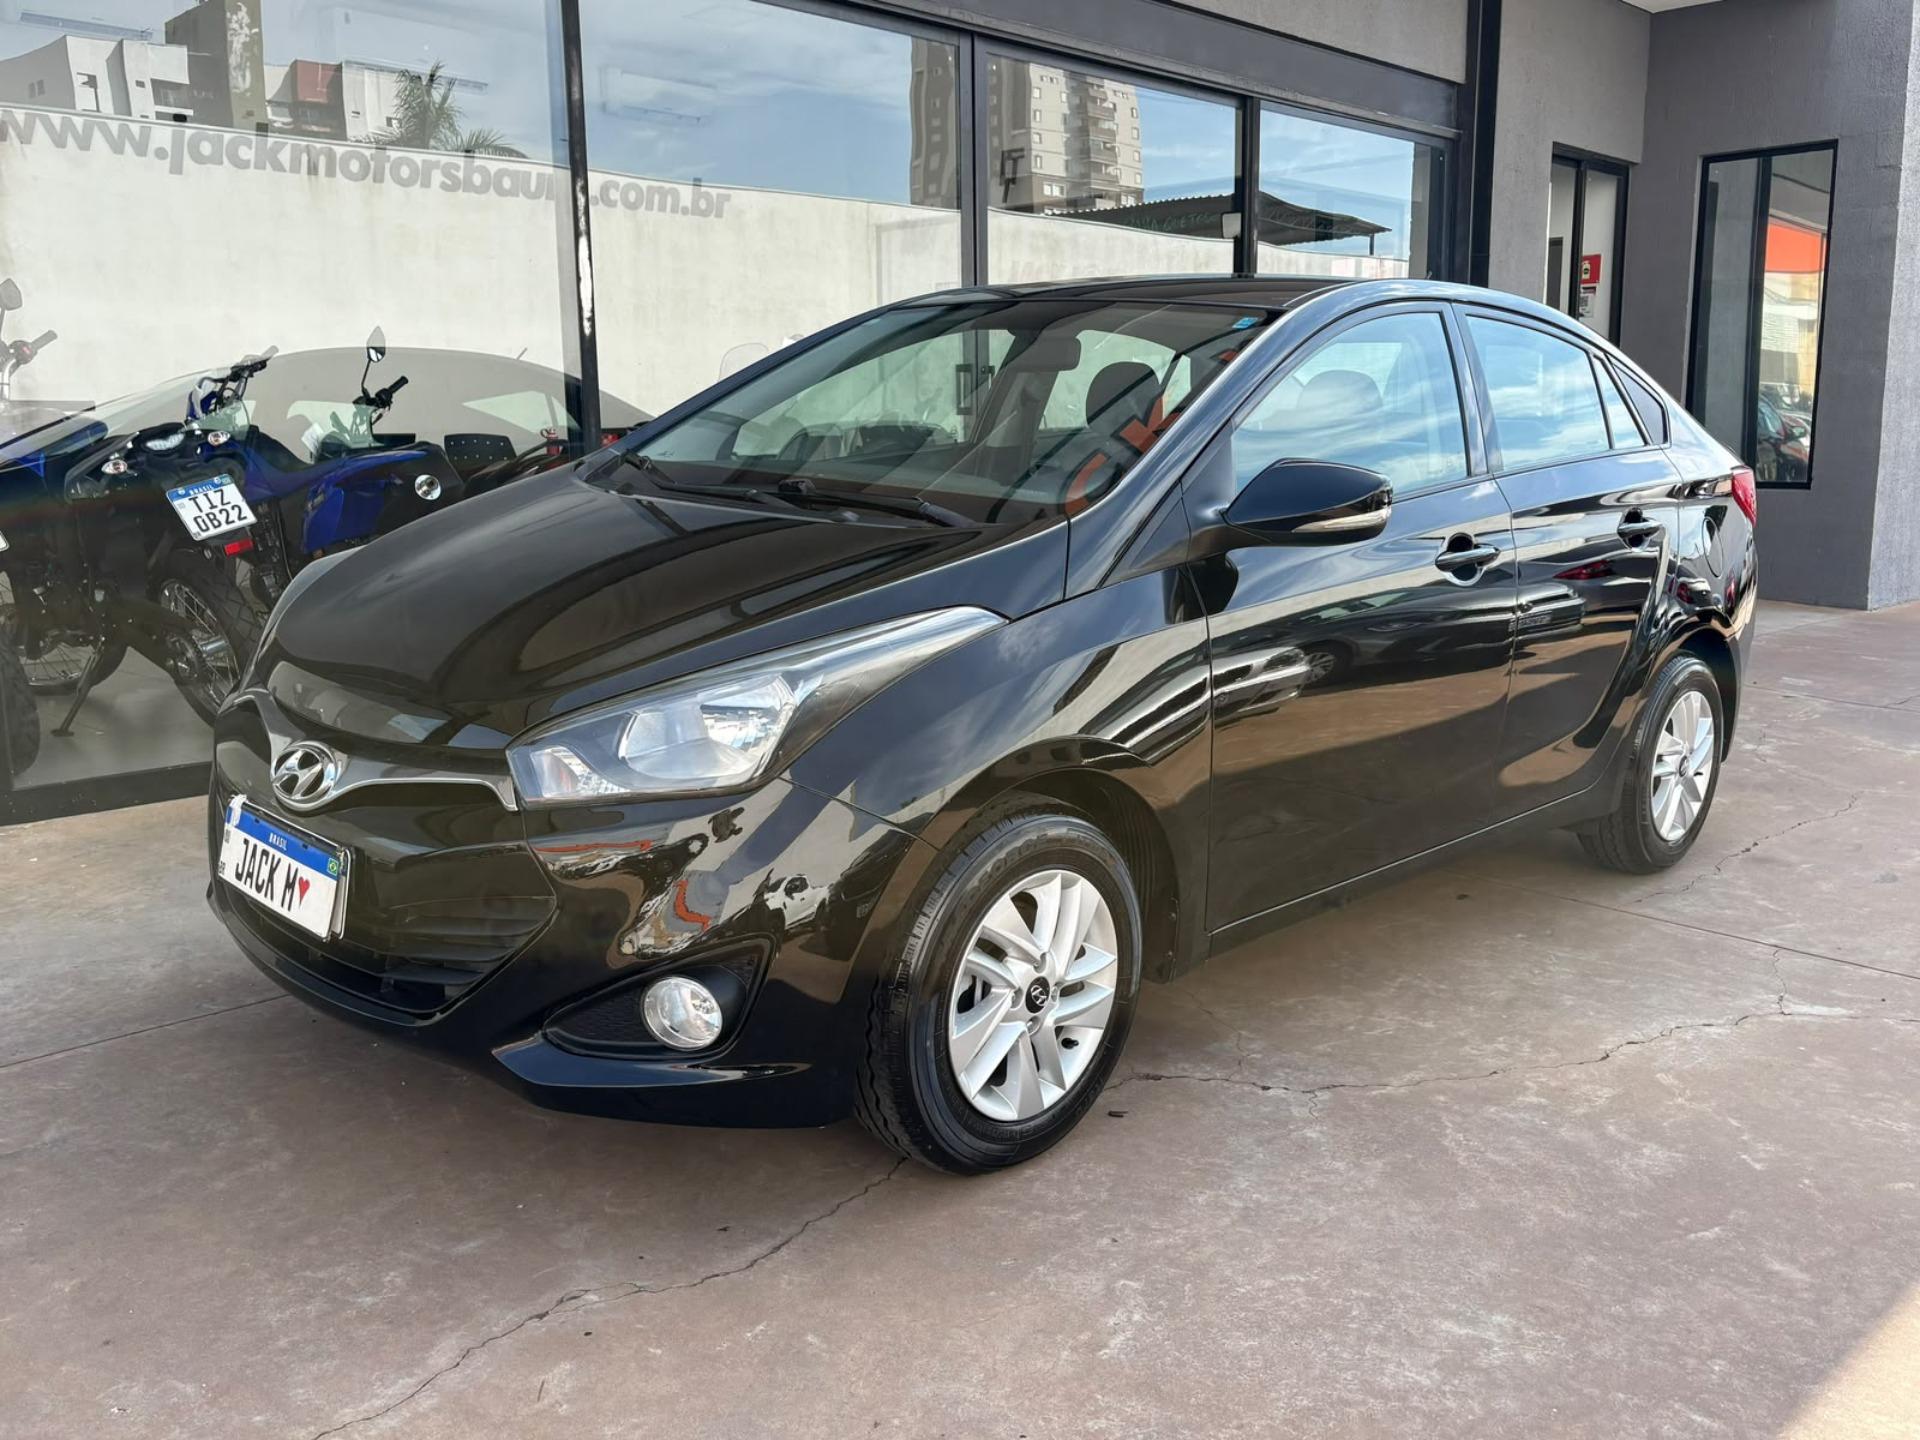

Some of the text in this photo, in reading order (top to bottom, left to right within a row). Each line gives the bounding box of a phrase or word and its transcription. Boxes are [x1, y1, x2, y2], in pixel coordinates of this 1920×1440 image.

[189, 489, 231, 513] TIZ
[269, 832, 288, 850] BRASIL
[235, 838, 299, 911] JACK M
